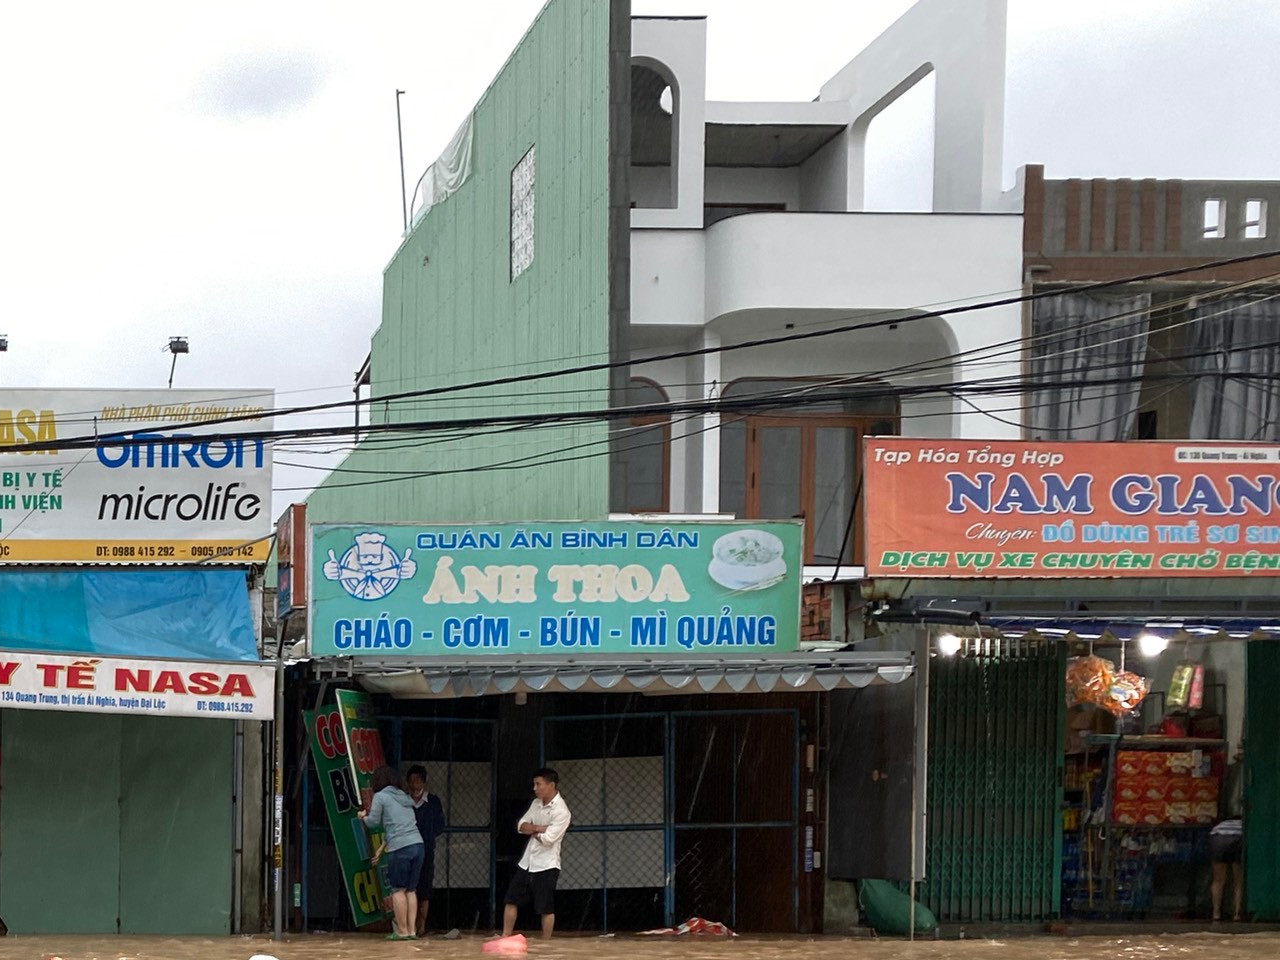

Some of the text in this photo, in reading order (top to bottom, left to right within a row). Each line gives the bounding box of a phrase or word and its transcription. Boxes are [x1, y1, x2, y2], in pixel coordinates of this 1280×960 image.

[100, 404, 126, 421] NHÀ
[128, 404, 161, 421] PHÂN
[160, 402, 190, 421] PHỐI
[191, 403, 228, 421] CHÍNH
[874, 445, 1064, 468] Tạp Hóa Tổng Hợp
[2, 472, 19, 490] BỊ
[26, 472, 36, 487] Y
[42, 468, 63, 488] TẾ
[22, 491, 62, 514] VIỆN
[98, 482, 261, 521] microlife
[945, 472, 1280, 516] NAM GIAN
[417, 528, 698, 548] QUÁN ĂN BÌNH DÂN
[1155, 520, 1200, 544] TRẺ
[1207, 523, 1240, 543] SƠ
[112, 546, 135, 556] 0988
[138, 546, 155, 556] 415
[158, 546, 175, 556] 292
[191, 546, 213, 557] 0905
[237, 546, 253, 557] 142
[880, 551, 950, 572] DỊCH
[955, 552, 995, 572] VỤ
[999, 552, 1037, 569] XE
[1042, 549, 1154, 569] CHUYÊN
[1160, 548, 1220, 569] CHỞ
[423, 556, 690, 604] ÁNH THOA
[334, 607, 776, 649] CHÁO CƠM BÚN MÌ QUẢNG
[36, 660, 103, 690] TẾ
[114, 668, 257, 698] NASA
[1, 691, 14, 702] 134
[15, 692, 38, 705] Quang
[61, 694, 70, 707] thị
[71, 693, 86, 706] trấn
[119, 697, 140, 710] huyện
[153, 698, 166, 711] Lộc
[208, 701, 253, 713] 0988.415.292
